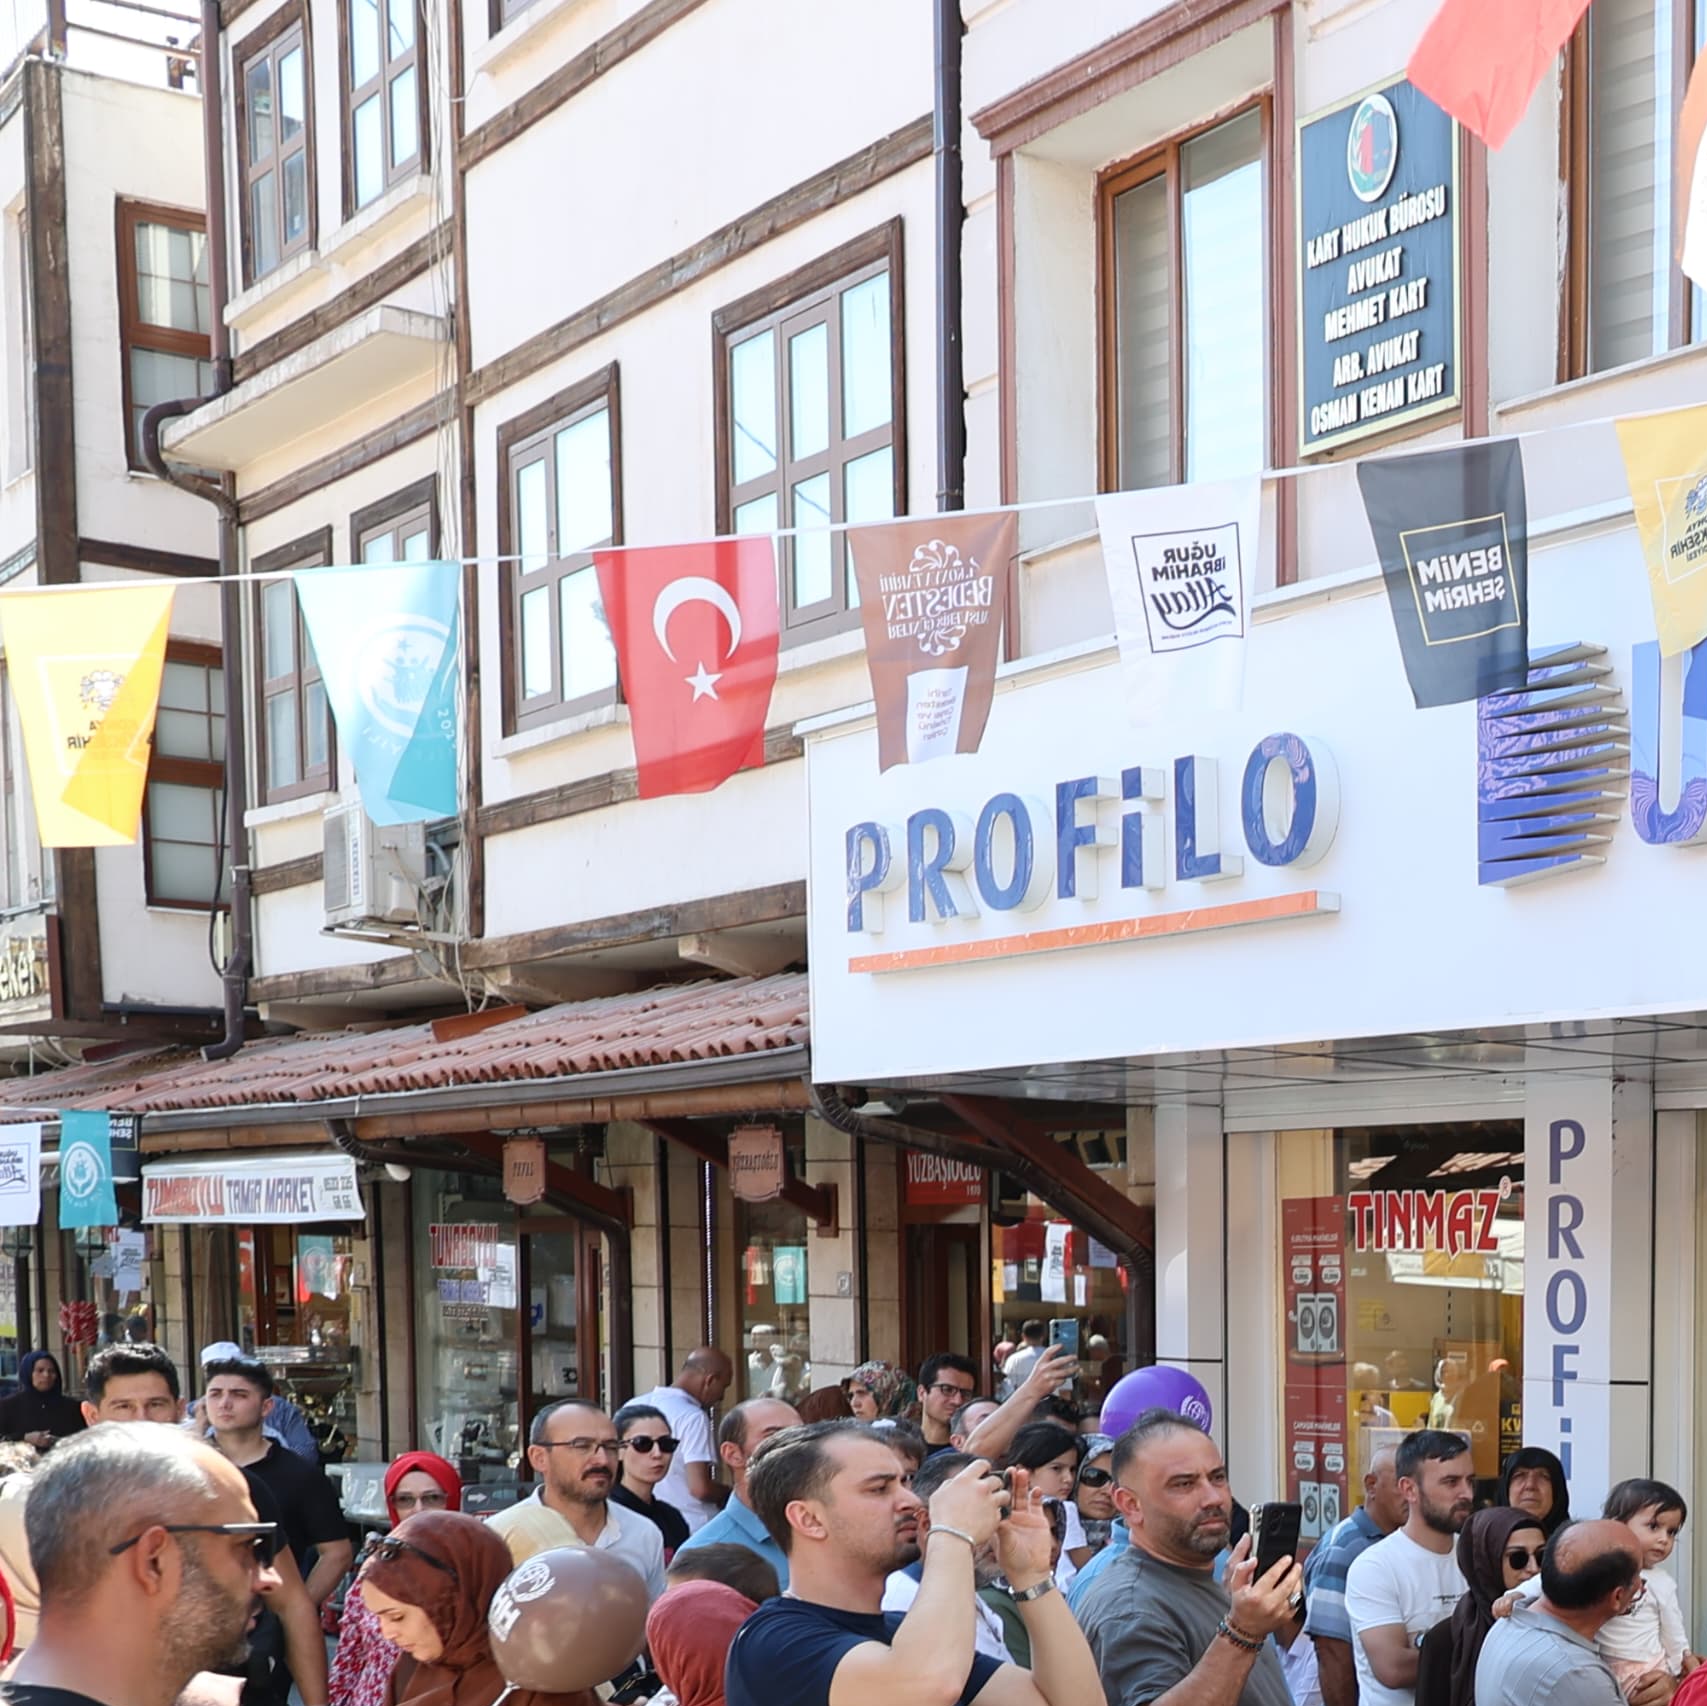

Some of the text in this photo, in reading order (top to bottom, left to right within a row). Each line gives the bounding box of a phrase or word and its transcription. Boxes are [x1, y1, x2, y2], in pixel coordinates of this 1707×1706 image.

[1307, 184, 1447, 269] KART HUKUK BÜROSU
[1347, 246, 1403, 295] AVUKAT
[1324, 276, 1428, 343] MEHMET KART
[1333, 330, 1420, 388] ARB. AVUKAT
[1311, 363, 1445, 436] OSMAN KENAN KART
[264, 1176, 317, 1214] MARKET
[1347, 1187, 1501, 1260] TINMAZ
